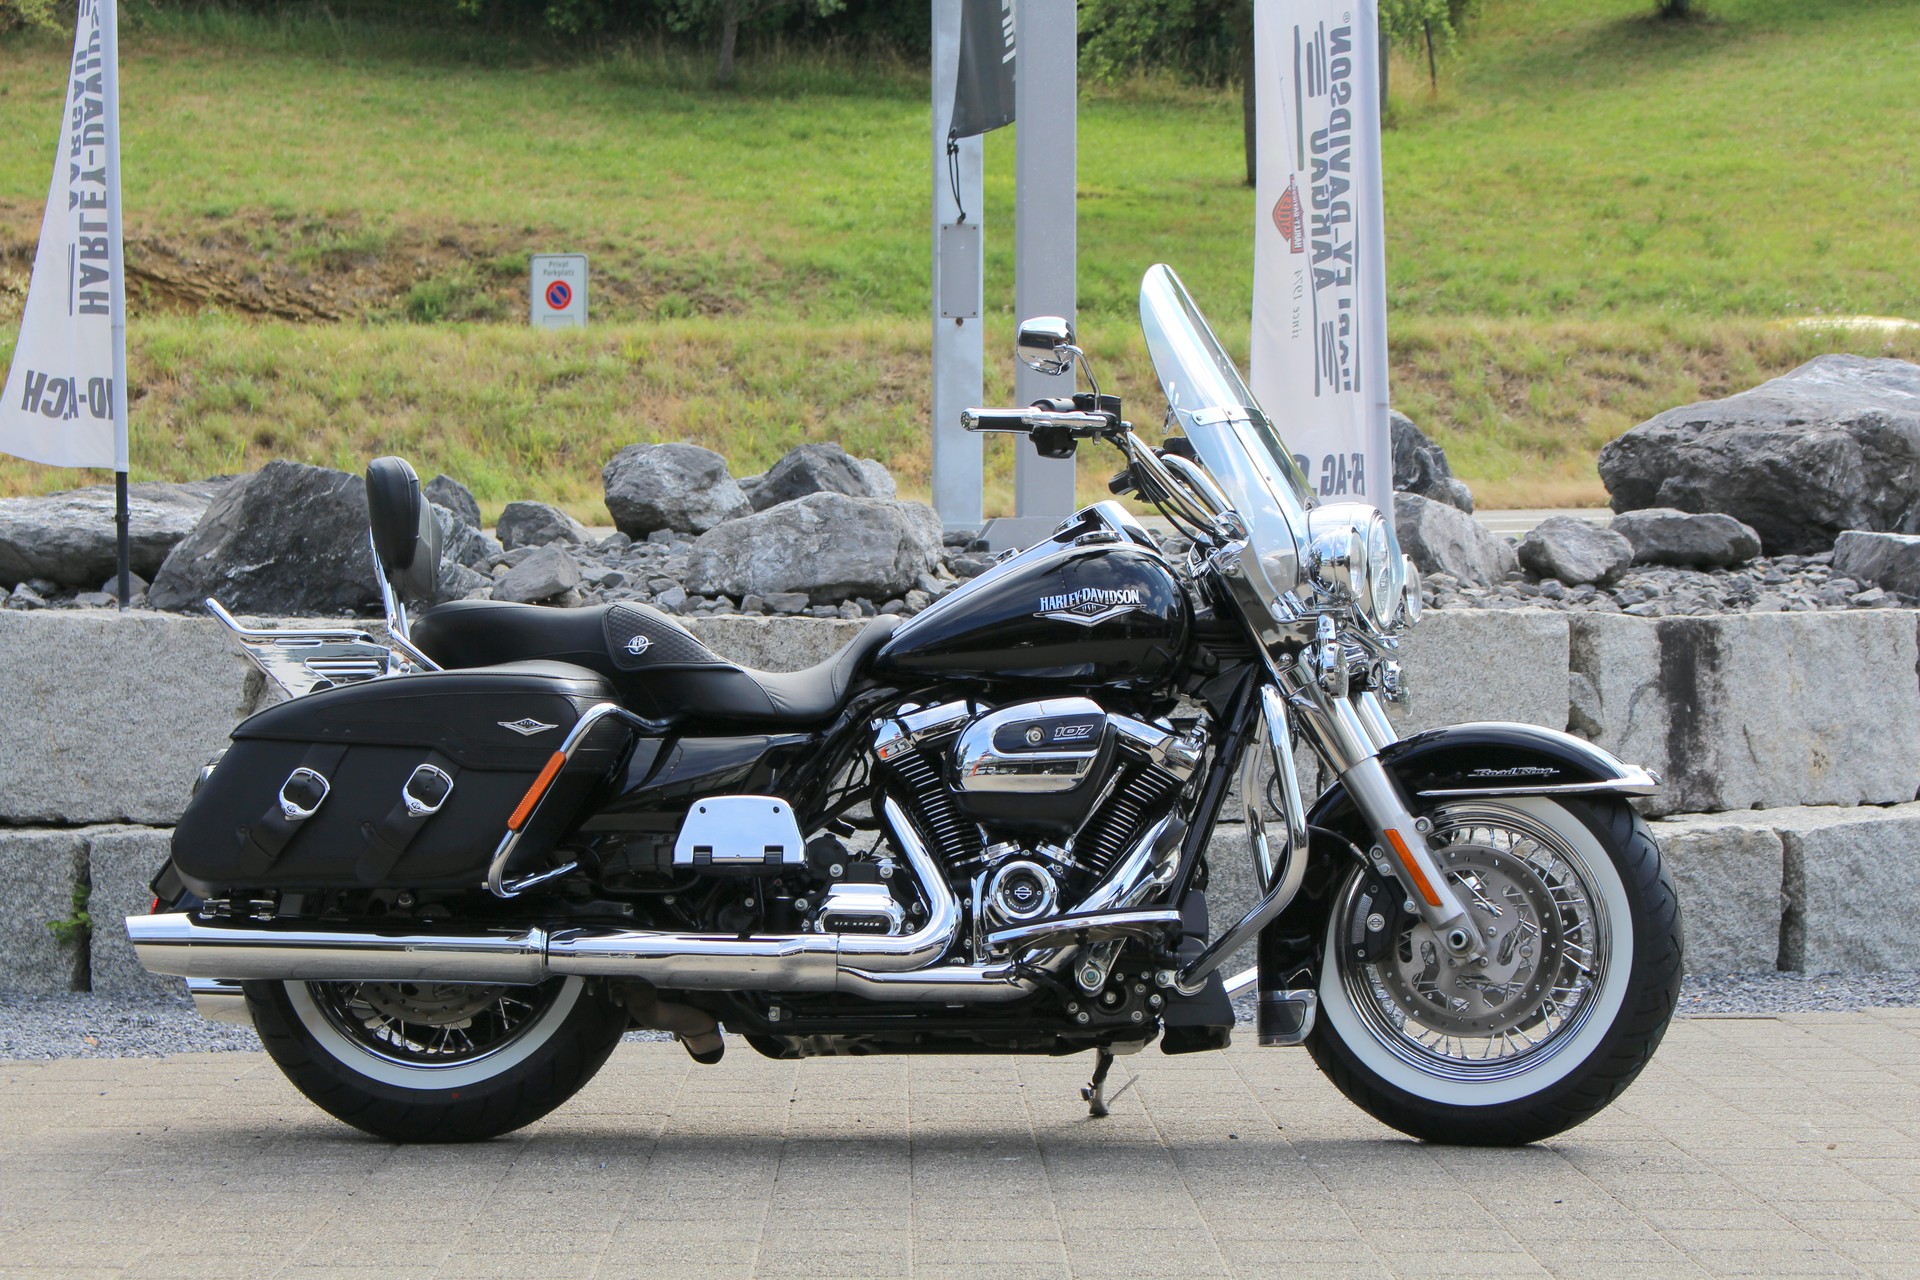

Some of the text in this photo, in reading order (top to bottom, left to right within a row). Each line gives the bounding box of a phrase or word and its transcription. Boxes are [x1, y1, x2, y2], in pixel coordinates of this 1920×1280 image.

[543, 269, 575, 277] Parkplatz
[1040, 587, 1141, 612] HARLEY-DAVIDSON
[1054, 724, 1094, 737] 107
[1473, 766, 1555, 778] Road King
